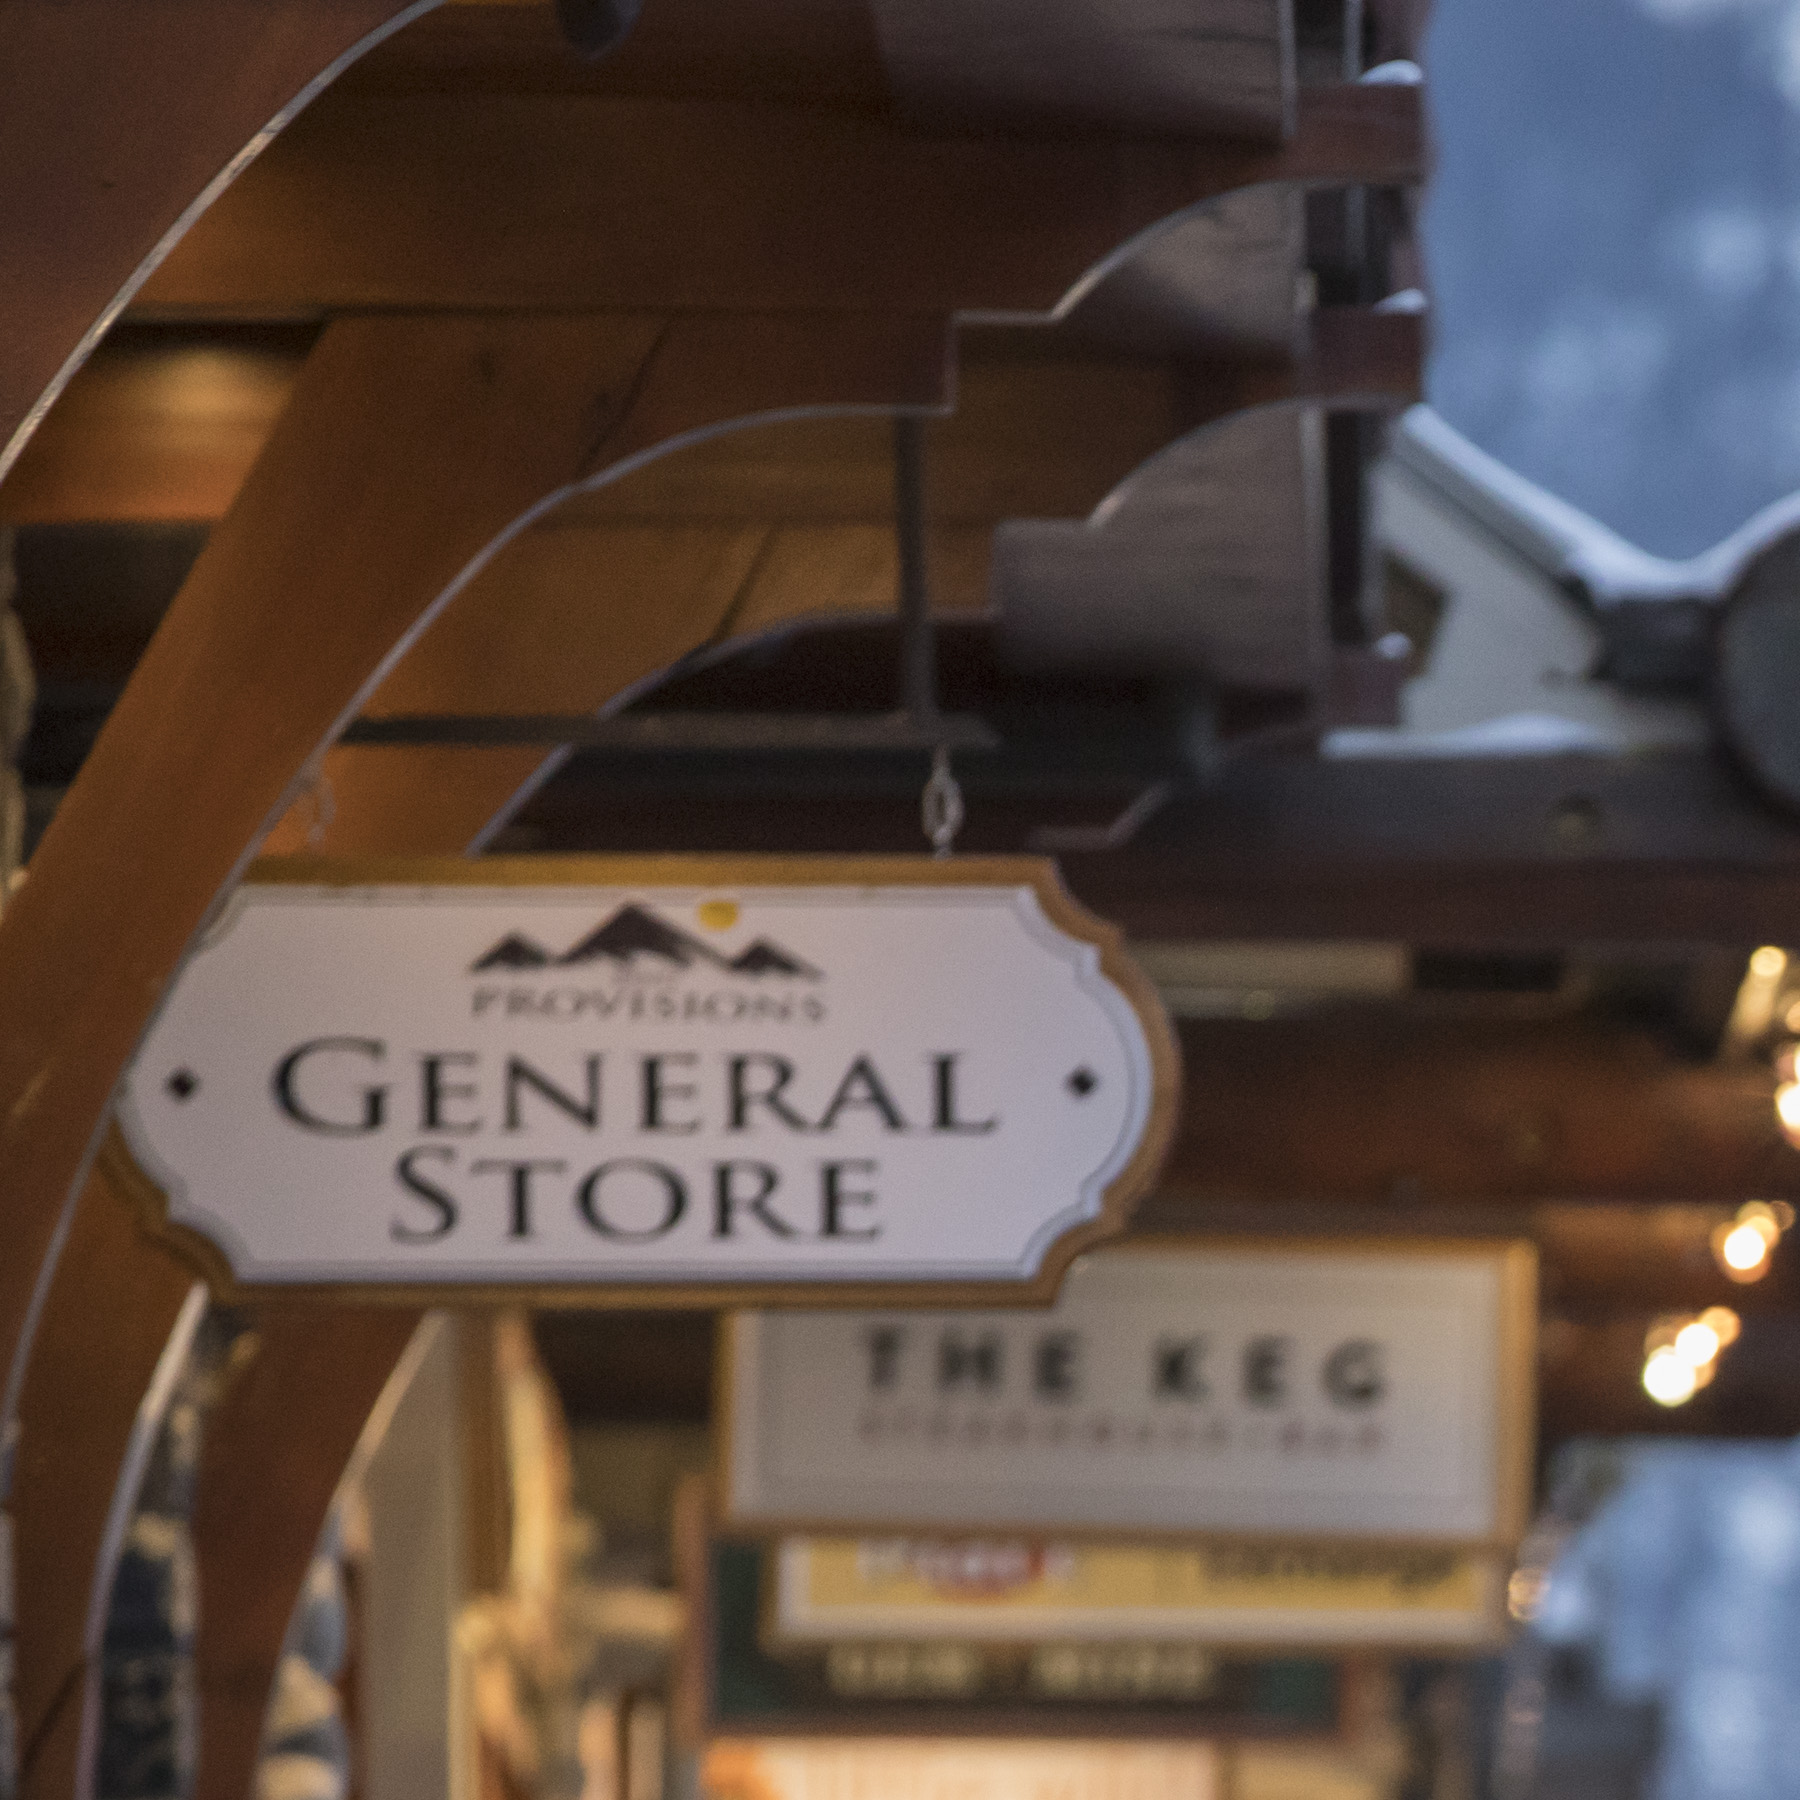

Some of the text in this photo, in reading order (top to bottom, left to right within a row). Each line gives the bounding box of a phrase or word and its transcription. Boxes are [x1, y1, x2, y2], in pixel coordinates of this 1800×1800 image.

[469, 985, 828, 1024] PROVISIONS
[272, 1034, 1000, 1136] GENERAL
[390, 1144, 882, 1244] STORE
[862, 1322, 1388, 1408] THE KEG
